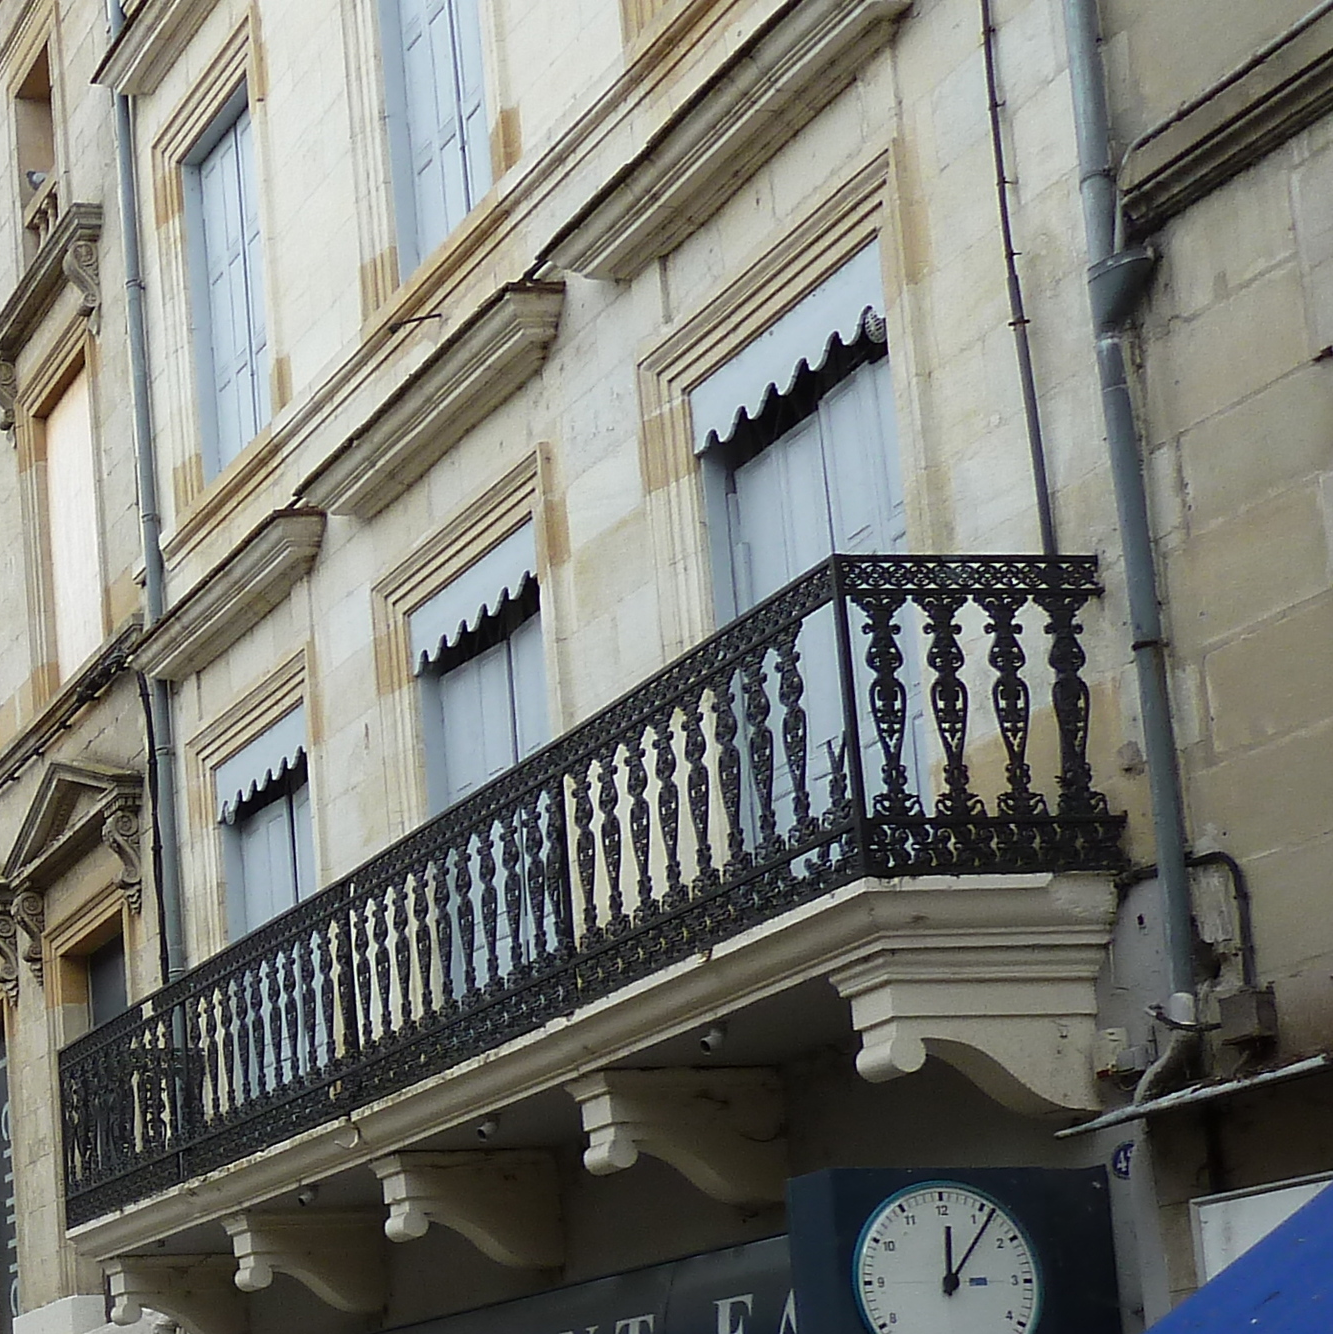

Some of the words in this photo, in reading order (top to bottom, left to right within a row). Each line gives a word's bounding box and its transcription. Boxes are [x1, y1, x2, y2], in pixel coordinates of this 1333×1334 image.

[936, 1205, 949, 1216] 12
[904, 1214, 916, 1225] 11
[971, 1214, 977, 1224] 1
[884, 1241, 895, 1252] 10
[996, 1238, 1004, 1249] 2
[877, 1277, 885, 1288] 9
[1011, 1275, 1019, 1286] 3
[889, 1313, 897, 1324] 8
[1005, 1310, 1013, 1320] 4
